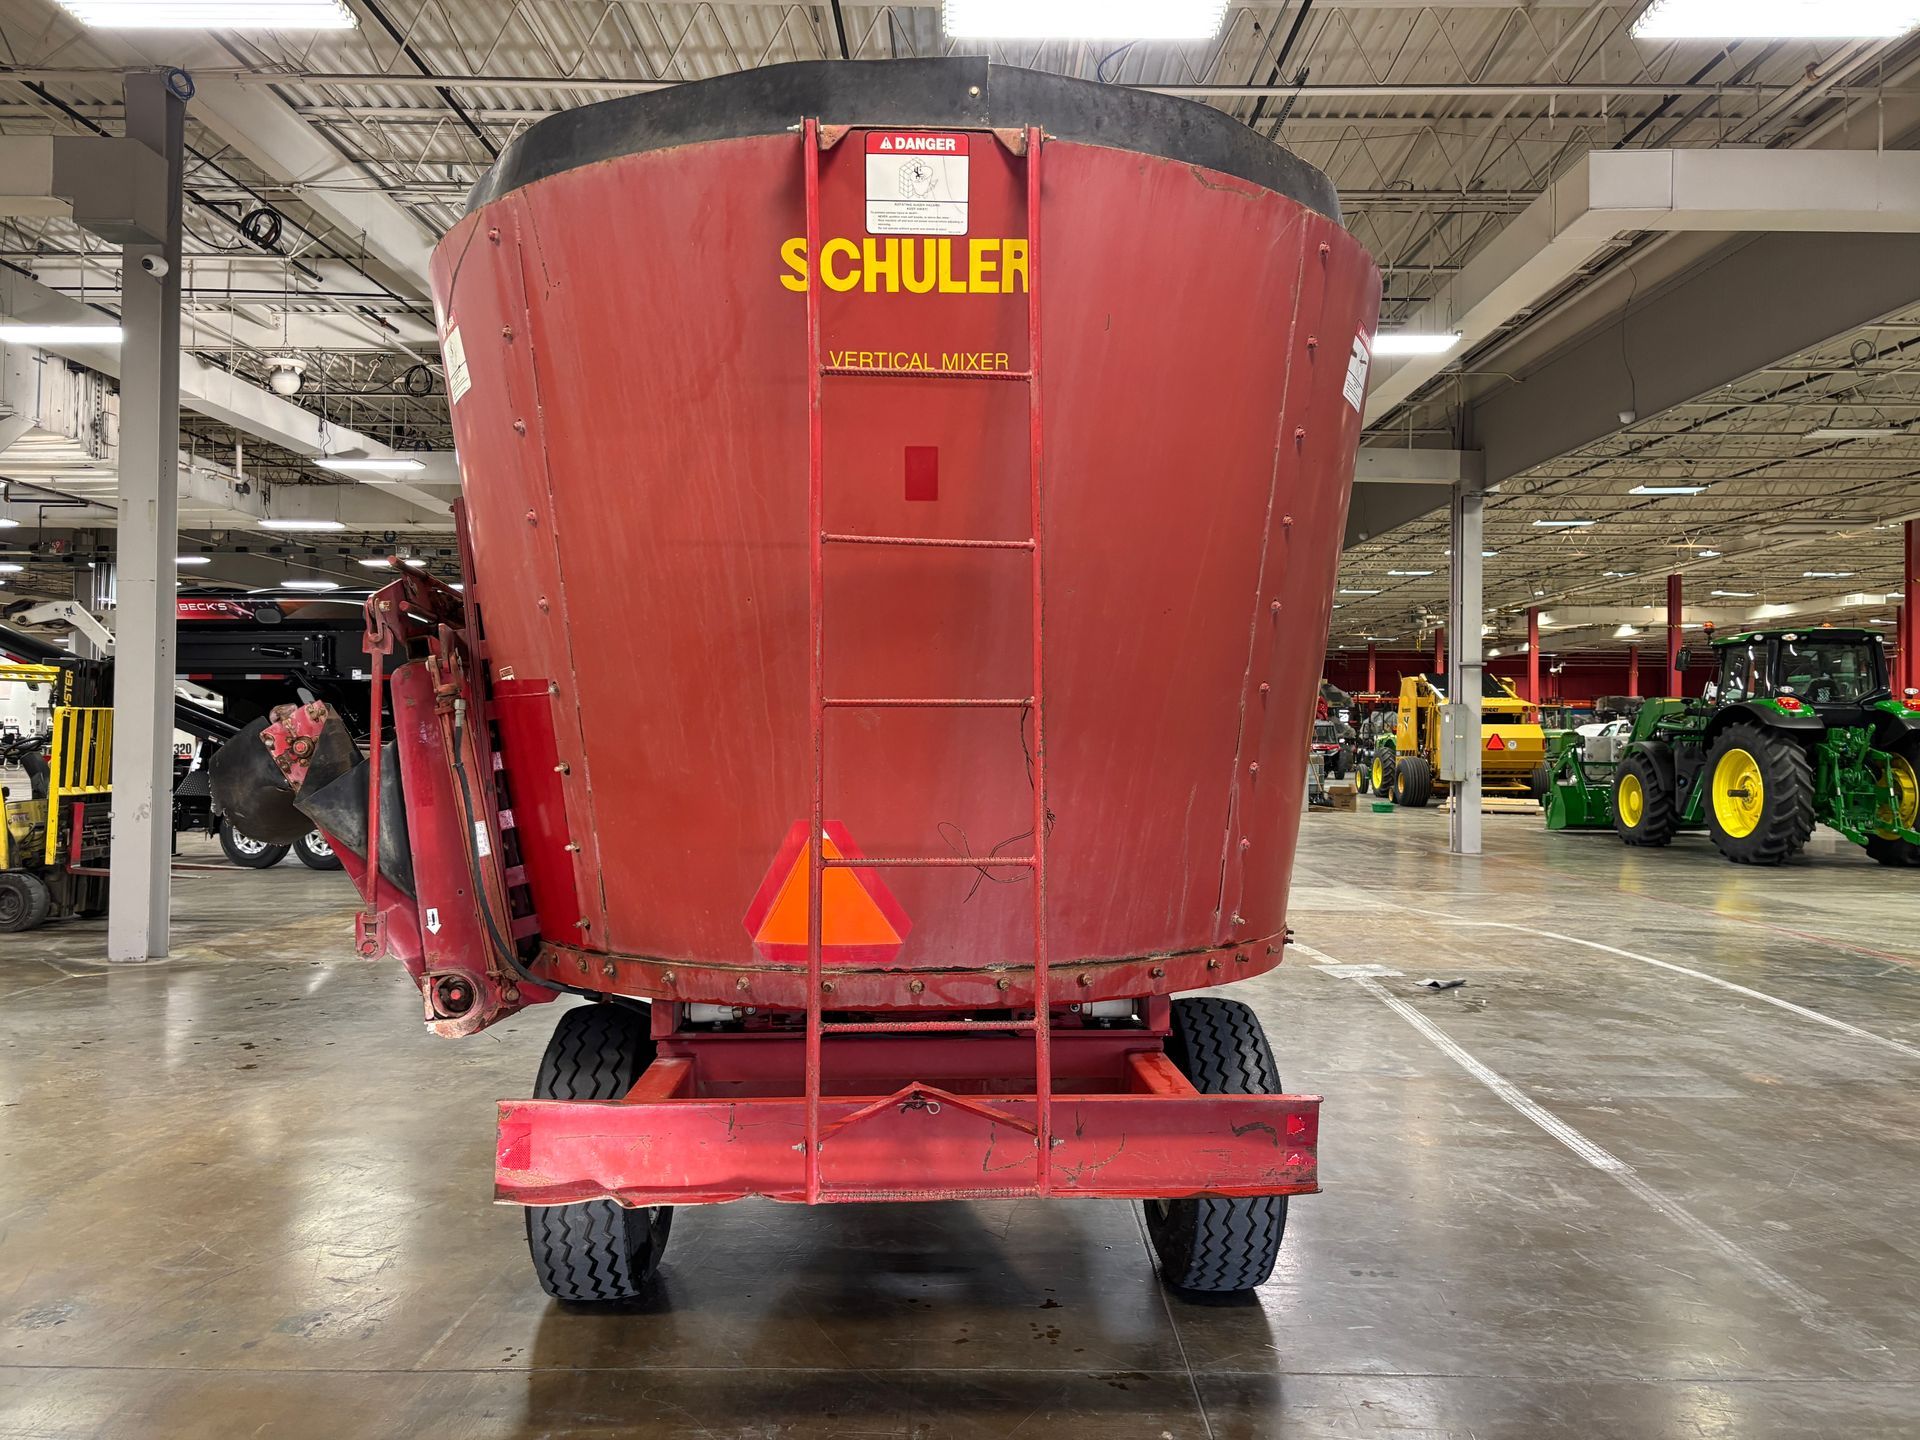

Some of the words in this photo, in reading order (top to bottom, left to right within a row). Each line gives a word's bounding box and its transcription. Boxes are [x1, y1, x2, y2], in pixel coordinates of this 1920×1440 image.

[895, 136, 956, 152] DANGER
[780, 237, 1029, 294] SCHULER
[829, 350, 935, 371] VERTICAL
[942, 352, 1009, 371] MIXER
[178, 602, 228, 611] BECK'S
[63, 669, 74, 718] HYSTER
